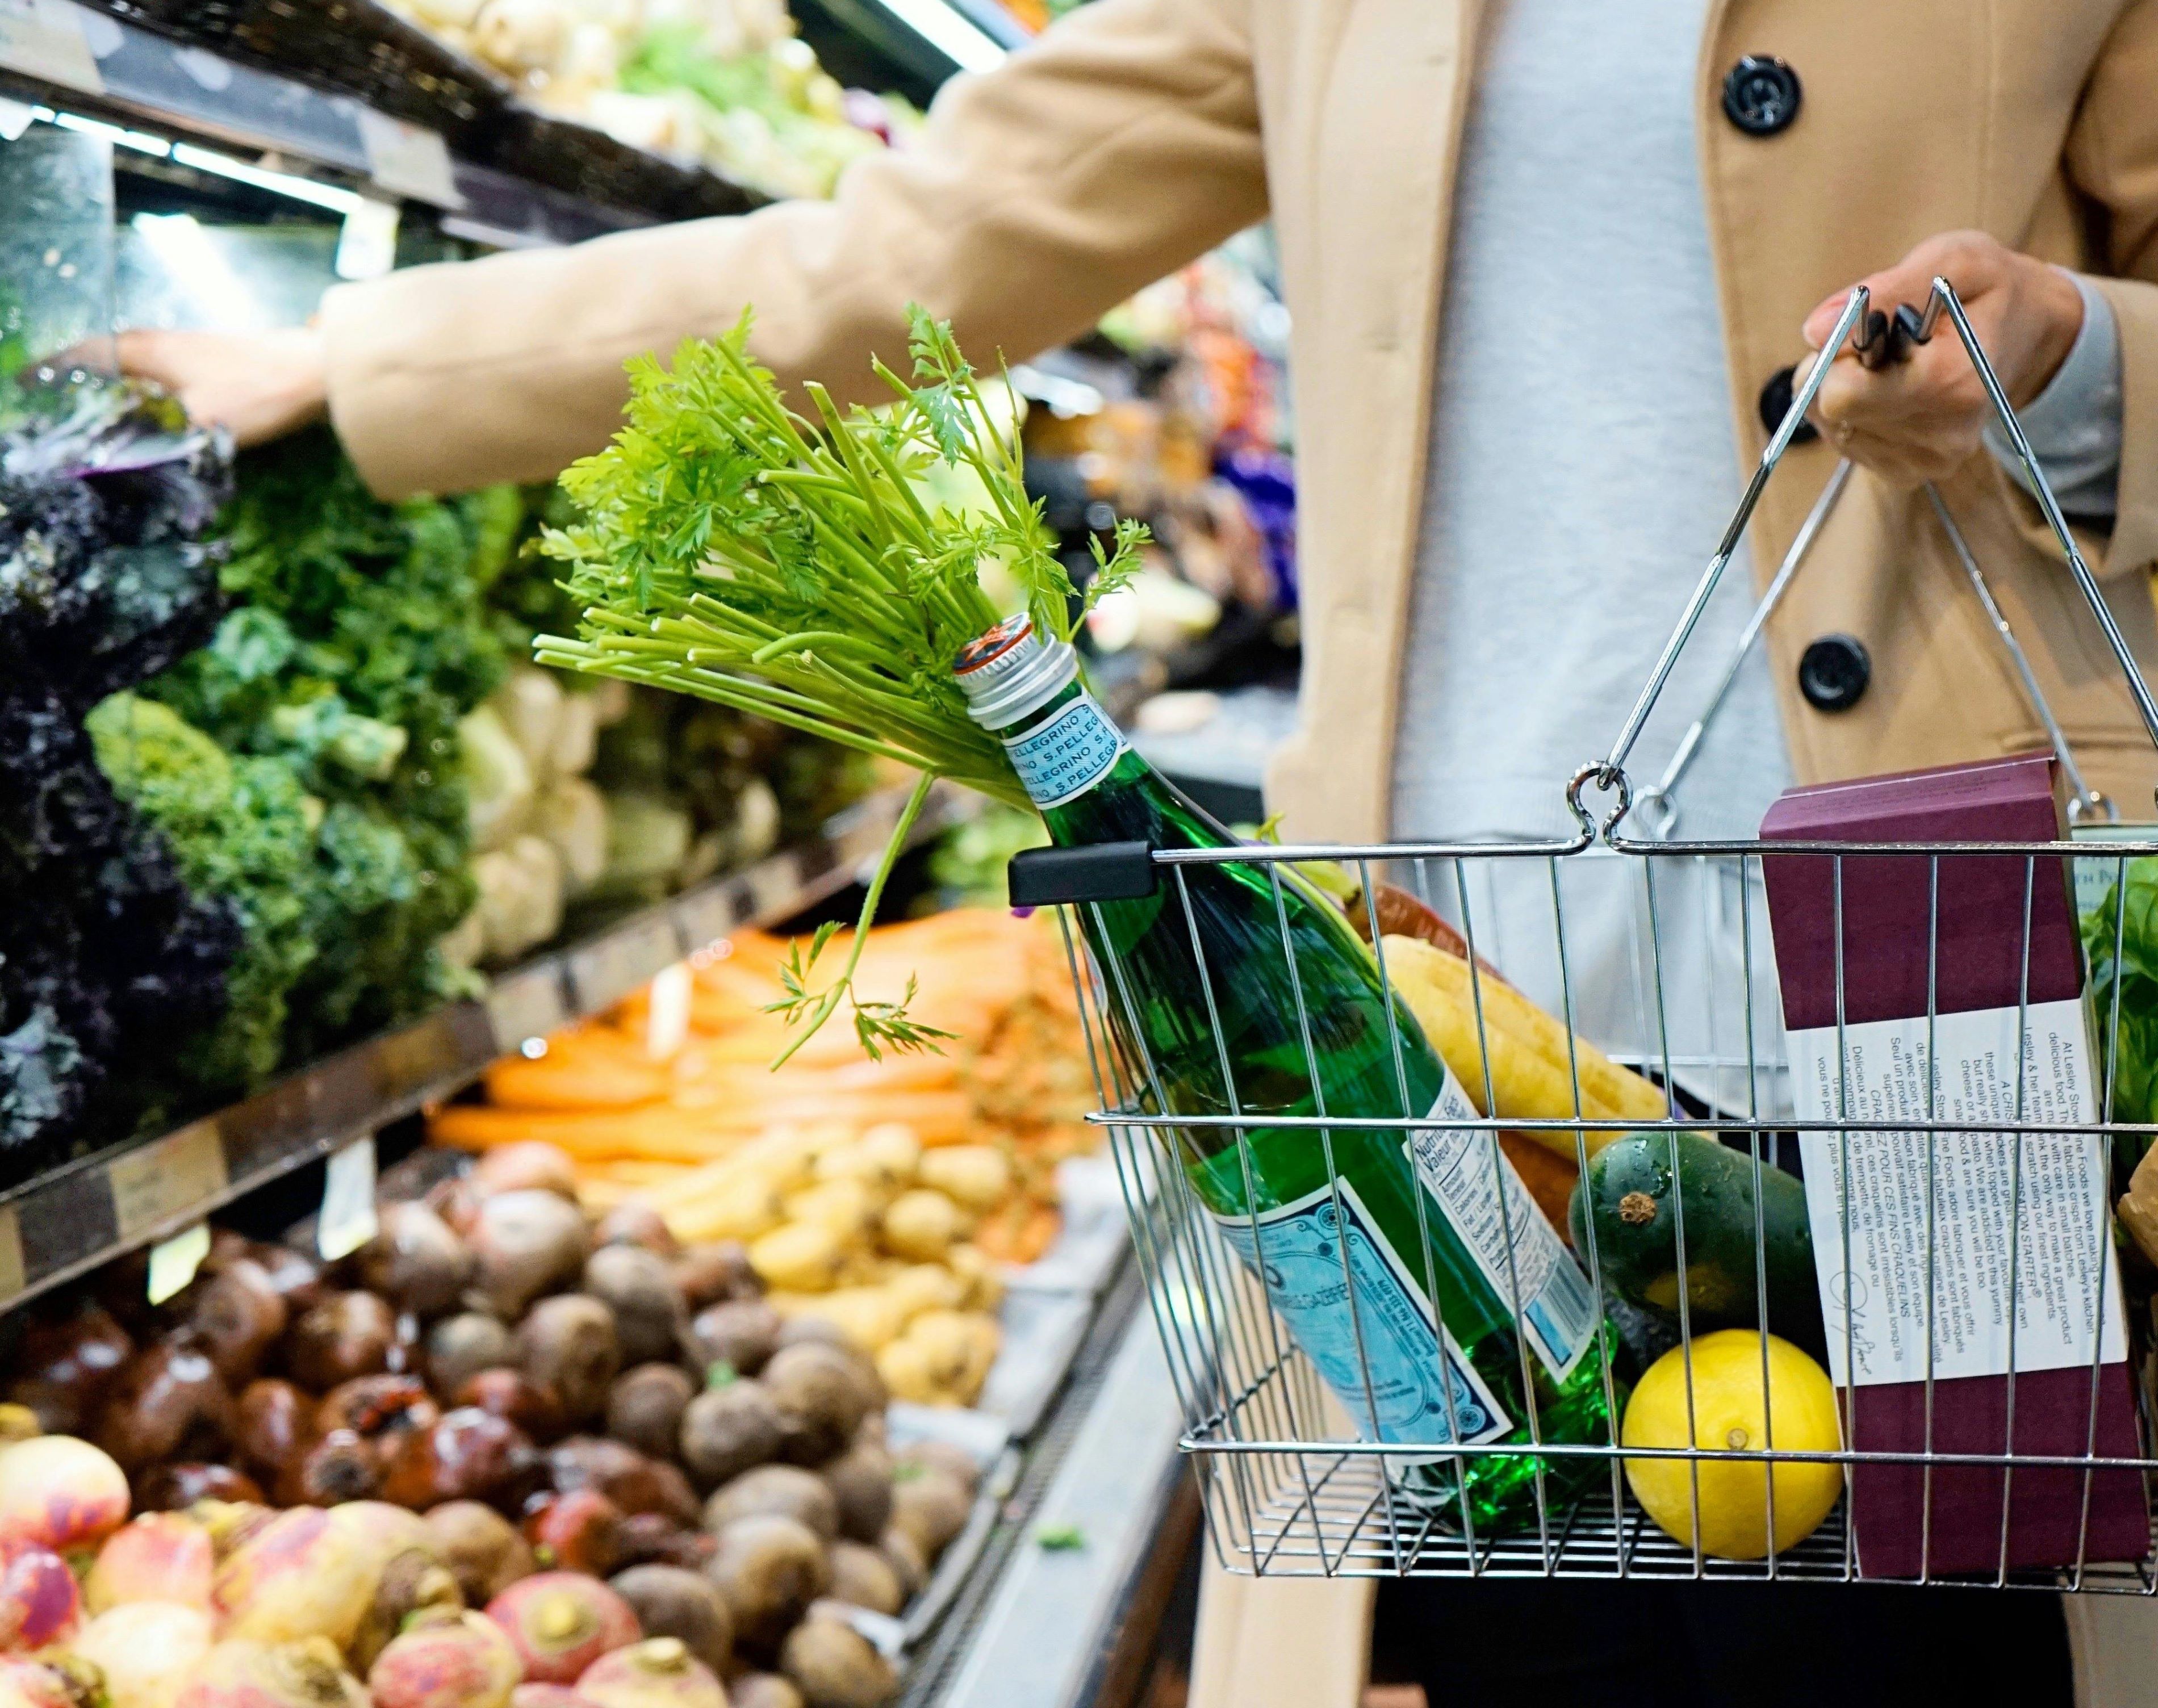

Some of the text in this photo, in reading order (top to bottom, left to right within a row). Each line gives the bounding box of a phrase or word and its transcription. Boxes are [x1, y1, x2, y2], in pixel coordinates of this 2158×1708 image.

[1890, 1037, 1902, 1061] Seul
[1916, 1042, 1926, 1056] de
[2062, 1041, 2072, 1053] At
[1852, 1046, 1867, 1093] Délicieux
[1894, 1064, 1903, 1076] un
[1905, 1052, 1914, 1077] avec
[1972, 1059, 1984, 1075] but
[1984, 1052, 1997, 1081] these
[2062, 1056, 2077, 1090] Lesley
[1960, 1059, 1974, 1098] cheese
[2001, 1079, 2009, 1089] A
[2029, 1075, 2040, 1092] her
[1859, 1096, 1867, 1110] au
[1881, 1073, 1898, 1123] supérieu
[1894, 1079, 1909, 1116] produit
[1906, 1080, 1921, 1104] soin,
[1973, 1079, 1988, 1107] really
[1986, 1084, 2001, 1120] unique
[2043, 1090, 2052, 1107] are
[1816, 1057, 1826, 1082] vous
[1821, 1084, 1829, 1097] ne
[1827, 1143, 1839, 1165] plus
[1912, 1108, 1920, 1121] en
[1935, 1094, 1948, 1124] Stow
[1953, 1099, 1964, 1124] snac
[1966, 1101, 1973, 1112] or
[2002, 1091, 2015, 1121] CRIS
[2032, 1096, 2042, 1122] team
[2046, 1110, 2059, 1139] me
[1852, 1141, 1863, 1154] de
[1889, 1132, 1904, 1169] pouvait
[1915, 1129, 1927, 1158] etites
[1993, 1123, 2008, 1166] ackers
[2036, 1131, 2047, 1151] ink
[2051, 1142, 2062, 1163] with
[1867, 1154, 1876, 1173] ces
[1879, 1149, 1892, 1183] POUR
[1984, 1140, 1996, 1168] when
[2025, 1141, 2039, 1178] scratch
[2039, 1154, 2050, 1170] the
[1854, 1157, 1870, 1209] trempette,
[1906, 1160, 1921, 1202] fabriqué
[1943, 1156, 1956, 1188] Foods
[1975, 1167, 1985, 1184] We
[1999, 1169, 2008, 1187] are
[2040, 1173, 2053, 1195] only
[2048, 1031, 2096, 1334] delicious food. The fabulous crisps from Lesley's kitchen
[2054, 1166, 2063, 1190] care
[2077, 1157, 2090, 1188] Foods
[1883, 1186, 1896, 1211] CES
[1897, 1172, 1911, 1219] satisfaire
[1934, 1178, 1948, 1221] fabuleux
[1965, 1190, 1974, 1212] sure
[1977, 1187, 1986, 1204] are
[1985, 1171, 2001, 1207] topped
[2027, 1181, 2042, 1209] using
[2057, 1192, 2067, 1202] in
[2082, 1192, 2090, 1207] we
[1868, 1175, 1885, 1228] craquelins
[1947, 1191, 1960, 1221] adore
[2043, 1198, 2054, 1219] way
[1863, 1212, 1872, 1225] de
[1887, 1213, 1899, 1240] FINS
[1913, 1204, 1922, 1228] avec
[1967, 1215, 1977, 1233] you
[1993, 1210, 2004, 1230] with
[2048, 1222, 2057, 1232] to
[2059, 1205, 2071, 1233] small
[2084, 1210, 2096, 1231] love
[1902, 1222, 1916, 1254] Lesley
[1980, 1207, 1994, 1251] addicted
[1863, 1228, 1878, 1271] fromage
[1877, 1231, 1888, 1253] sont
[1916, 1232, 1927, 1251] des
[1938, 1224, 1955, 1278] craquelins
[1950, 1224, 1967, 1270] fabriquer
[1972, 1236, 1983, 1253] will
[1993, 1233, 2005, 1256] your
[2037, 1232, 2050, 1260] finest
[2050, 1234, 2061, 1263] make
[1908, 1257, 1917, 1267] et
[1975, 1255, 1984, 1269] be
[1986, 1254, 1995, 1264] to
[1871, 1274, 1879, 1287] ou
[1891, 1242, 1910, 1318] CRAQUELINS
[1959, 1272, 1968, 1282] et
[1988, 1267, 1998, 1286] this
[1938, 1294, 1947, 1308] de
[1948, 1280, 1958, 1303] sont
[1960, 1286, 1970, 1309] vous
[2053, 1276, 2066, 1303] great
[1988, 1288, 2002, 1326] yummy
[2017, 1307, 2027, 1329] own
[1964, 1312, 1976, 1336] offrir
[2056, 1305, 2072, 1345] product
